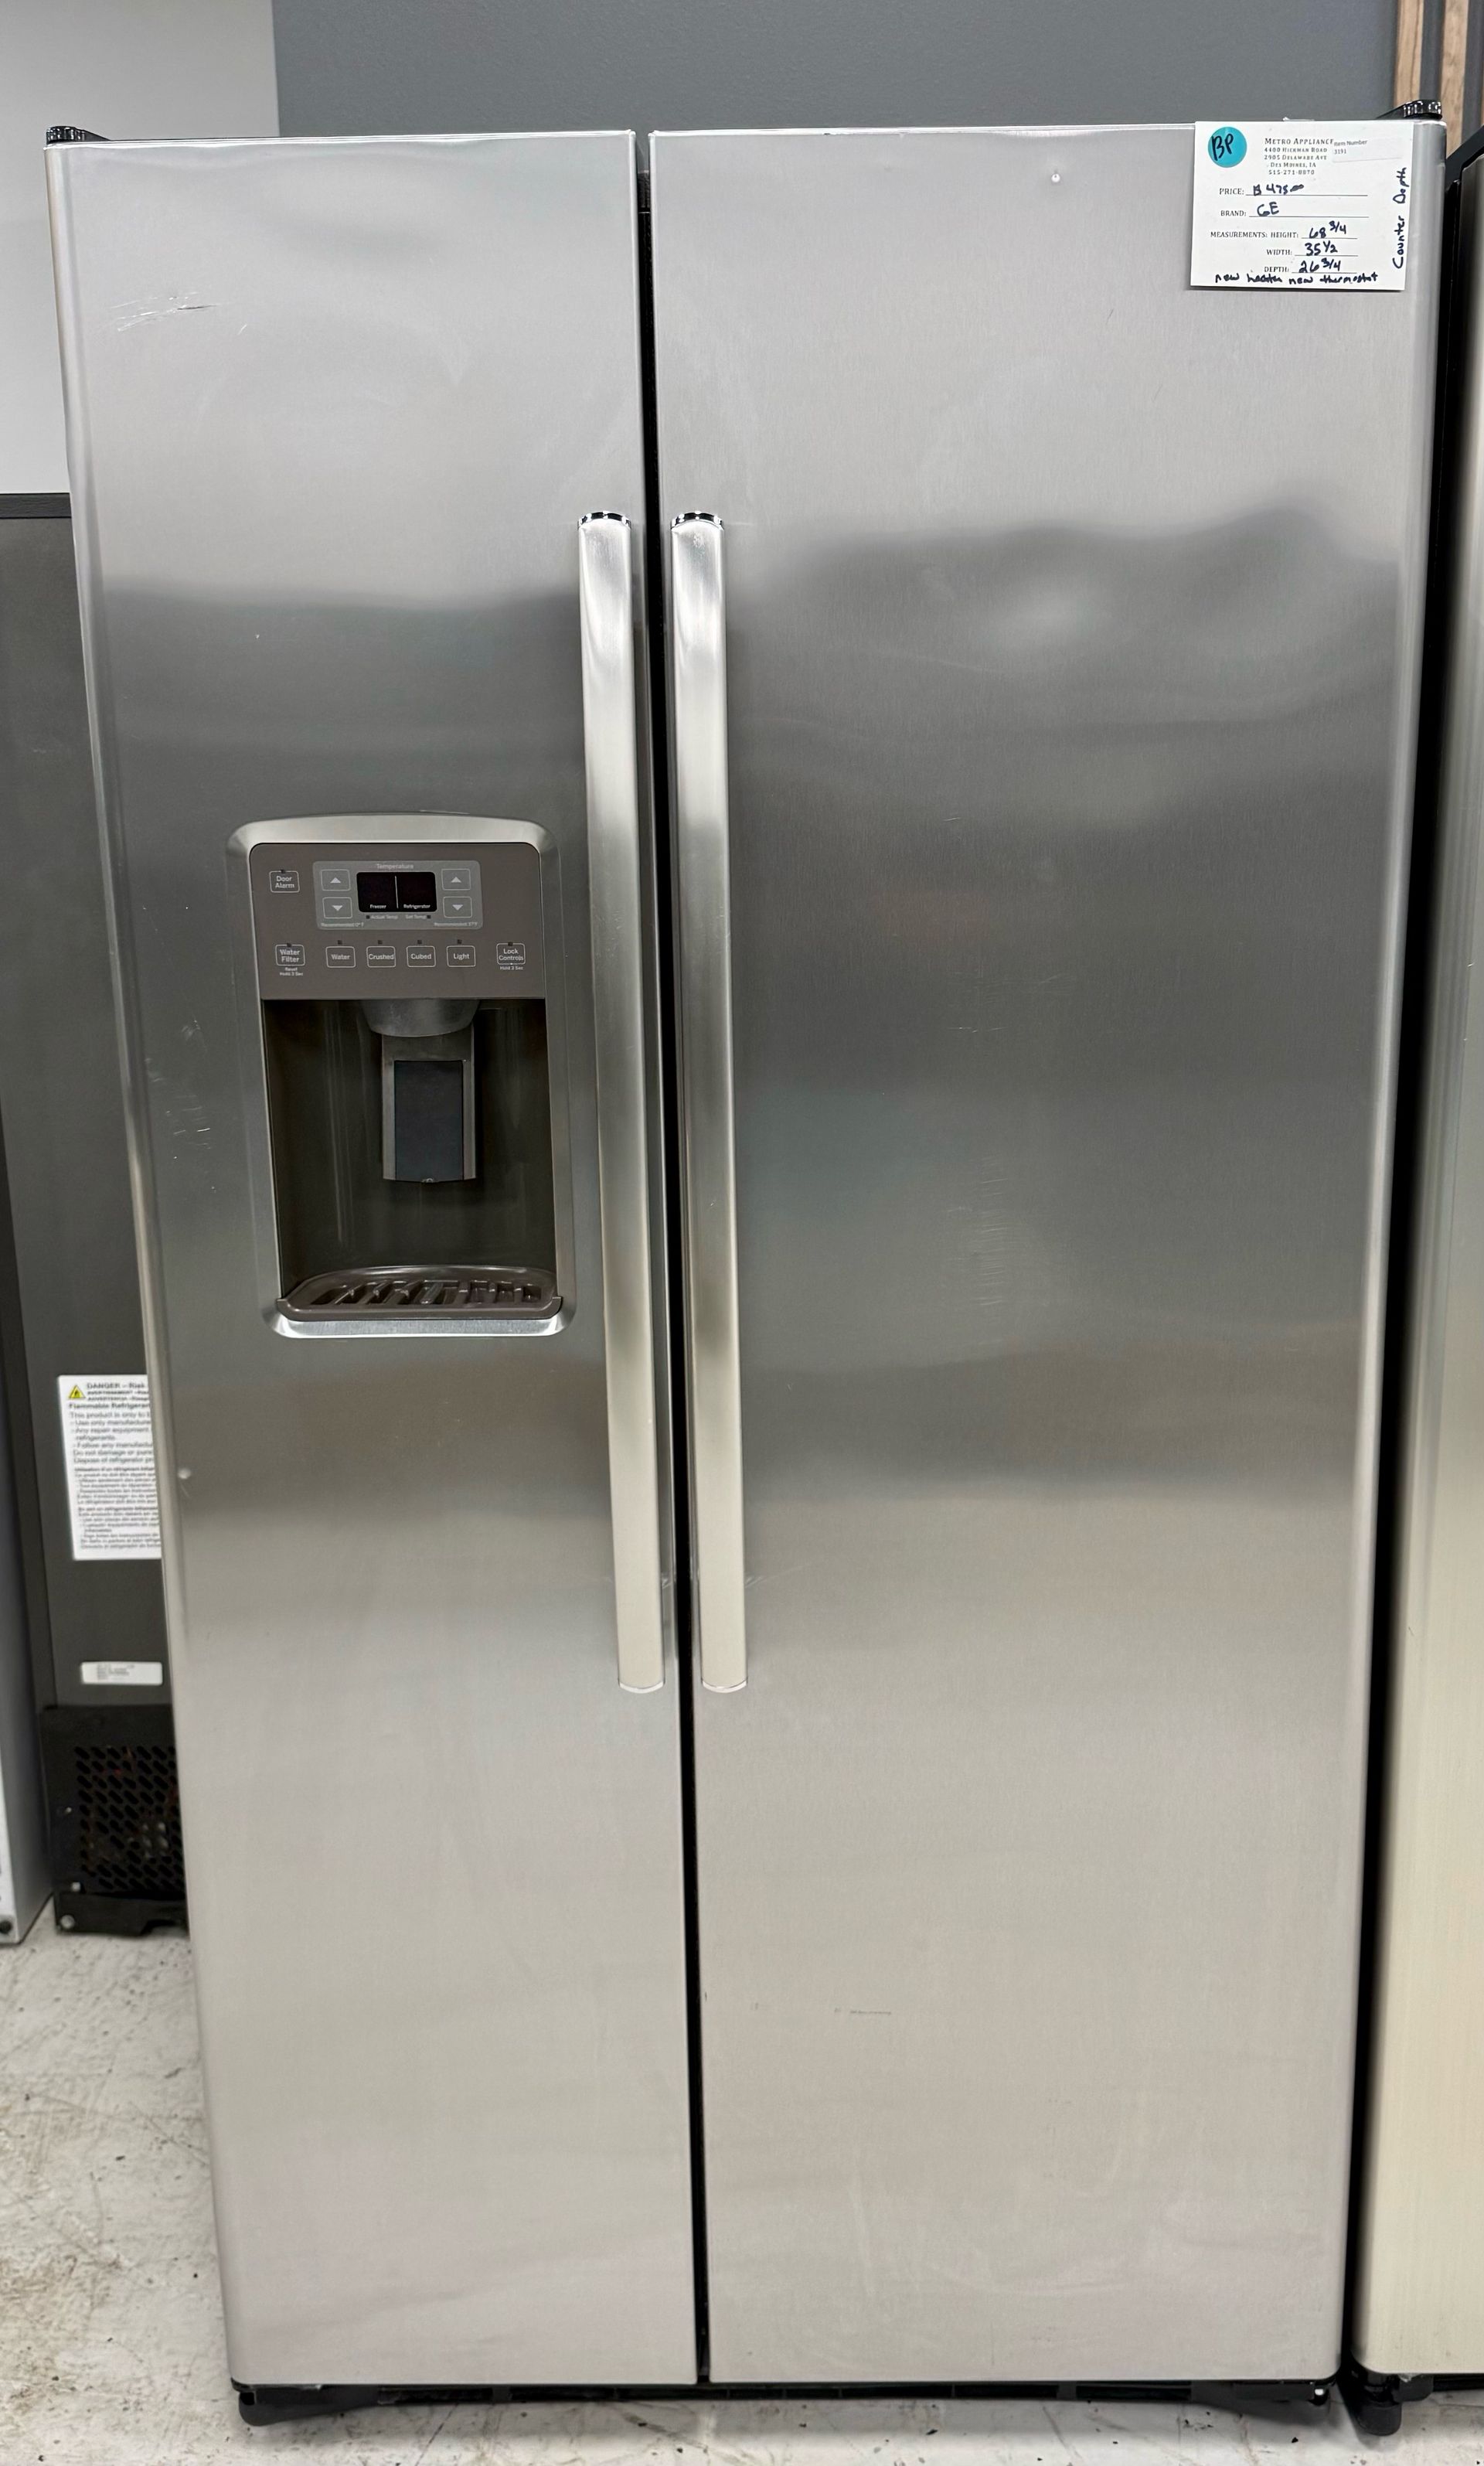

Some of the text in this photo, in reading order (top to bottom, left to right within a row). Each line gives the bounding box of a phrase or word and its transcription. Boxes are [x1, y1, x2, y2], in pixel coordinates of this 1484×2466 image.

[1211, 133, 1234, 162] BP
[1257, 201, 1279, 216] GE
[1305, 243, 1321, 256] 35
